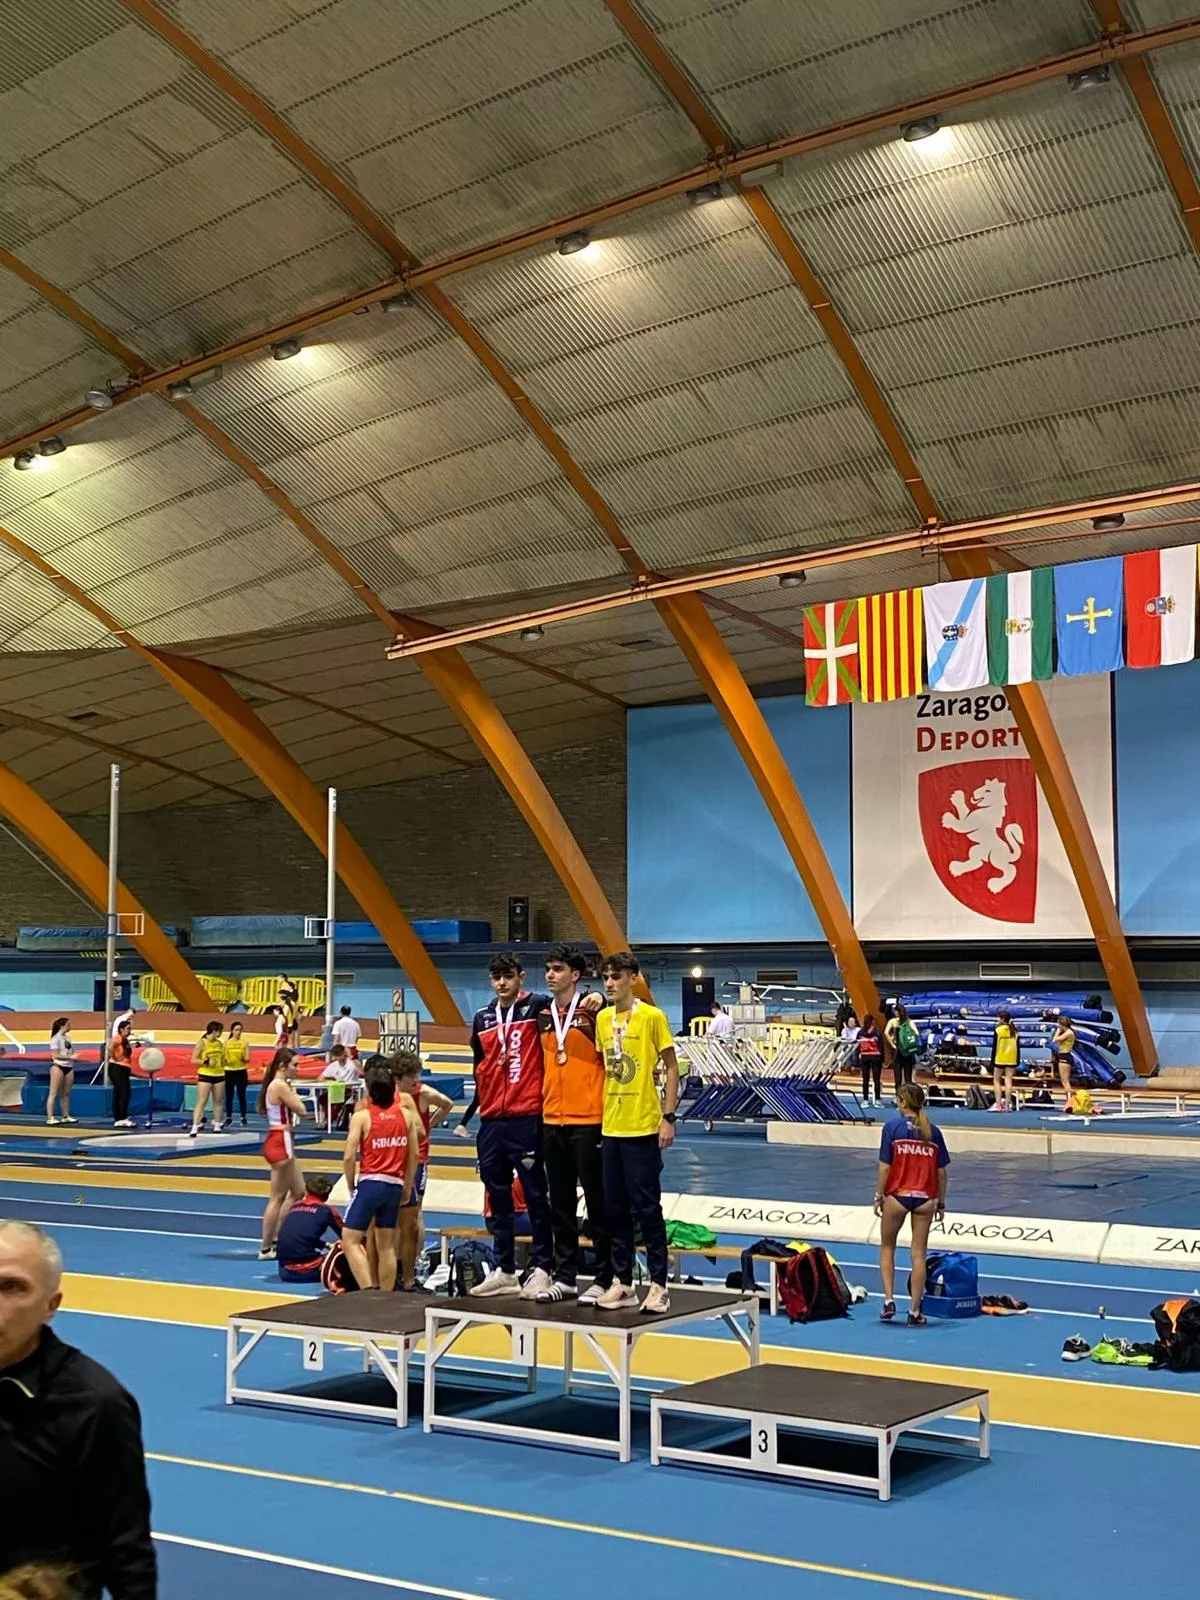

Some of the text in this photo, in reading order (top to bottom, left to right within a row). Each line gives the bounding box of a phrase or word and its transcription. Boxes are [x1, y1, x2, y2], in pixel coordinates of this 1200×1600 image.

[917, 694, 1011, 721] Zarago
[393, 990, 401, 1007] 2
[708, 1206, 831, 1225] ZARAGOZA
[928, 1222, 1054, 1243] ARAGOZA
[308, 1341, 317, 1362] 2
[519, 1334, 525, 1355] 1
[758, 1429, 768, 1453] 3
